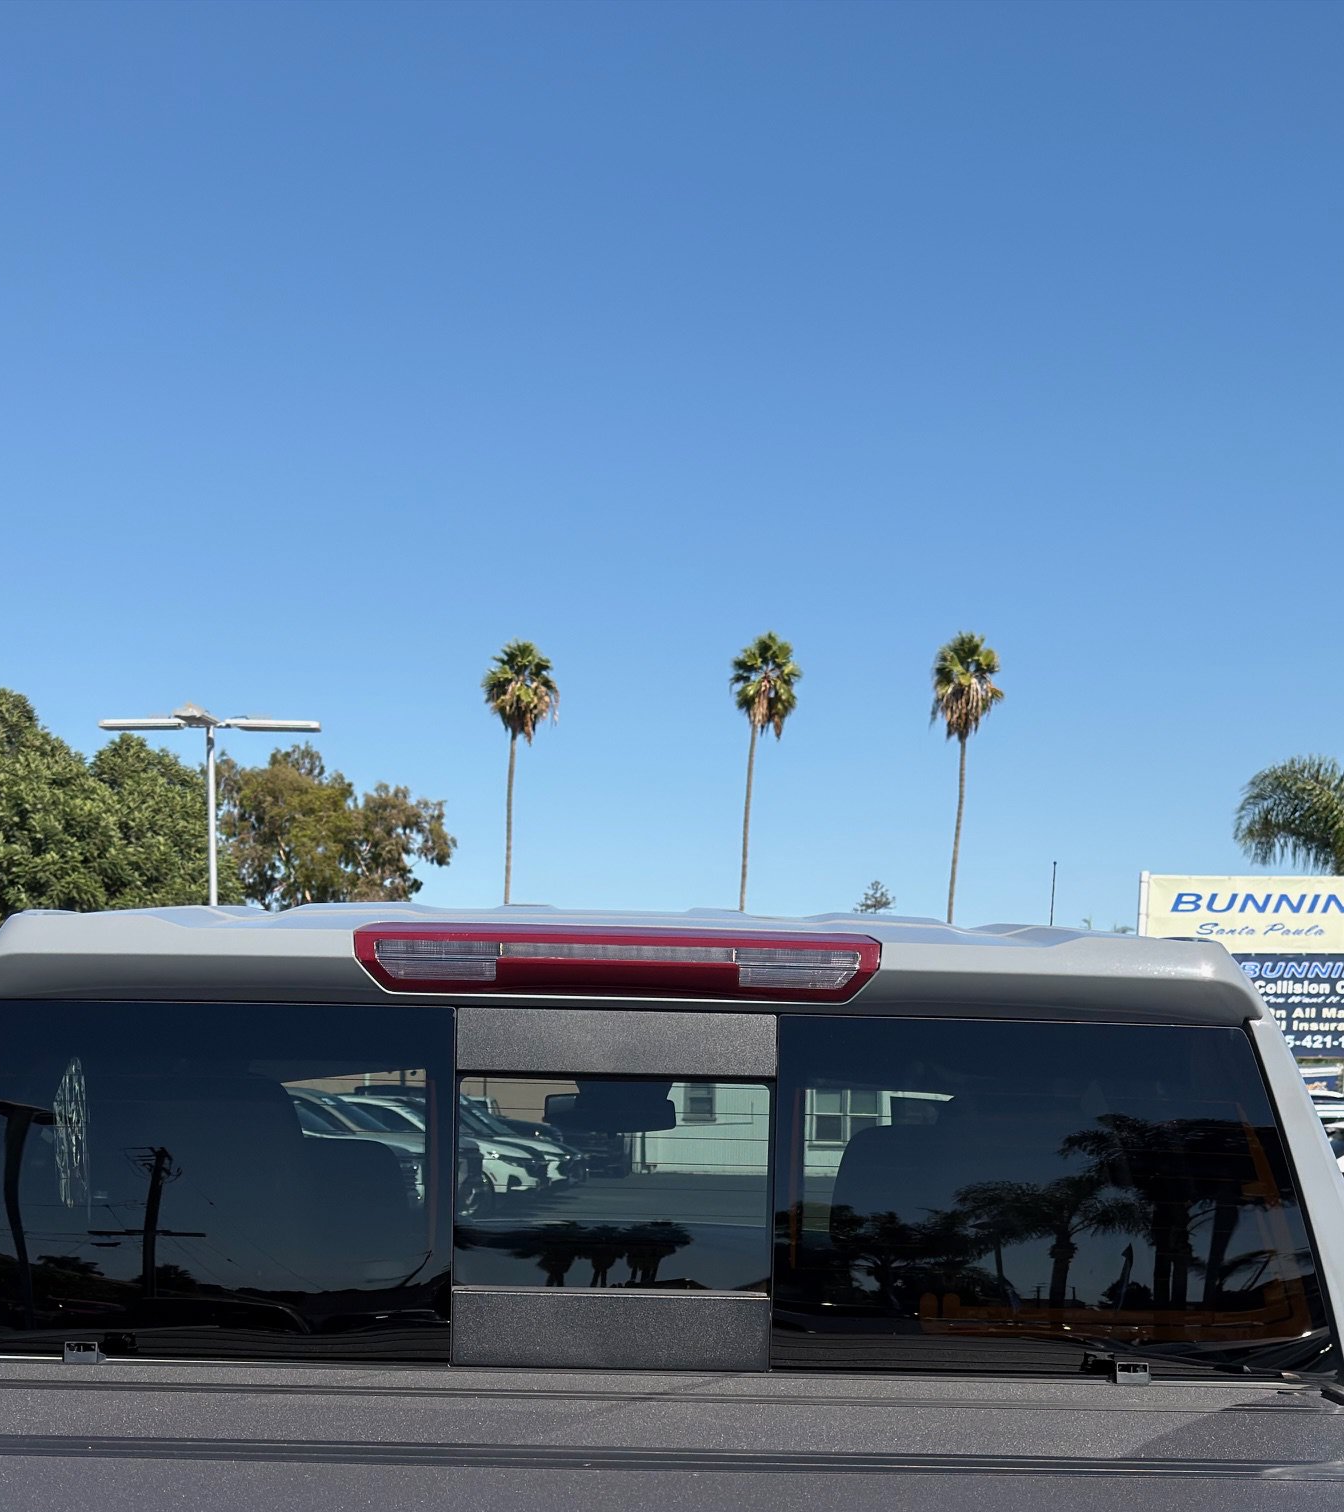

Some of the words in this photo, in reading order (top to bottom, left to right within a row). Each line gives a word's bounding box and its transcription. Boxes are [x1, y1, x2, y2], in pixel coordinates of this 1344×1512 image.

[1195, 922, 1257, 937] Santa
[1262, 922, 1327, 937] Paula
[1256, 980, 1331, 995] Collision
[1288, 995, 1326, 1004] Want
[1291, 1007, 1316, 1019] All
